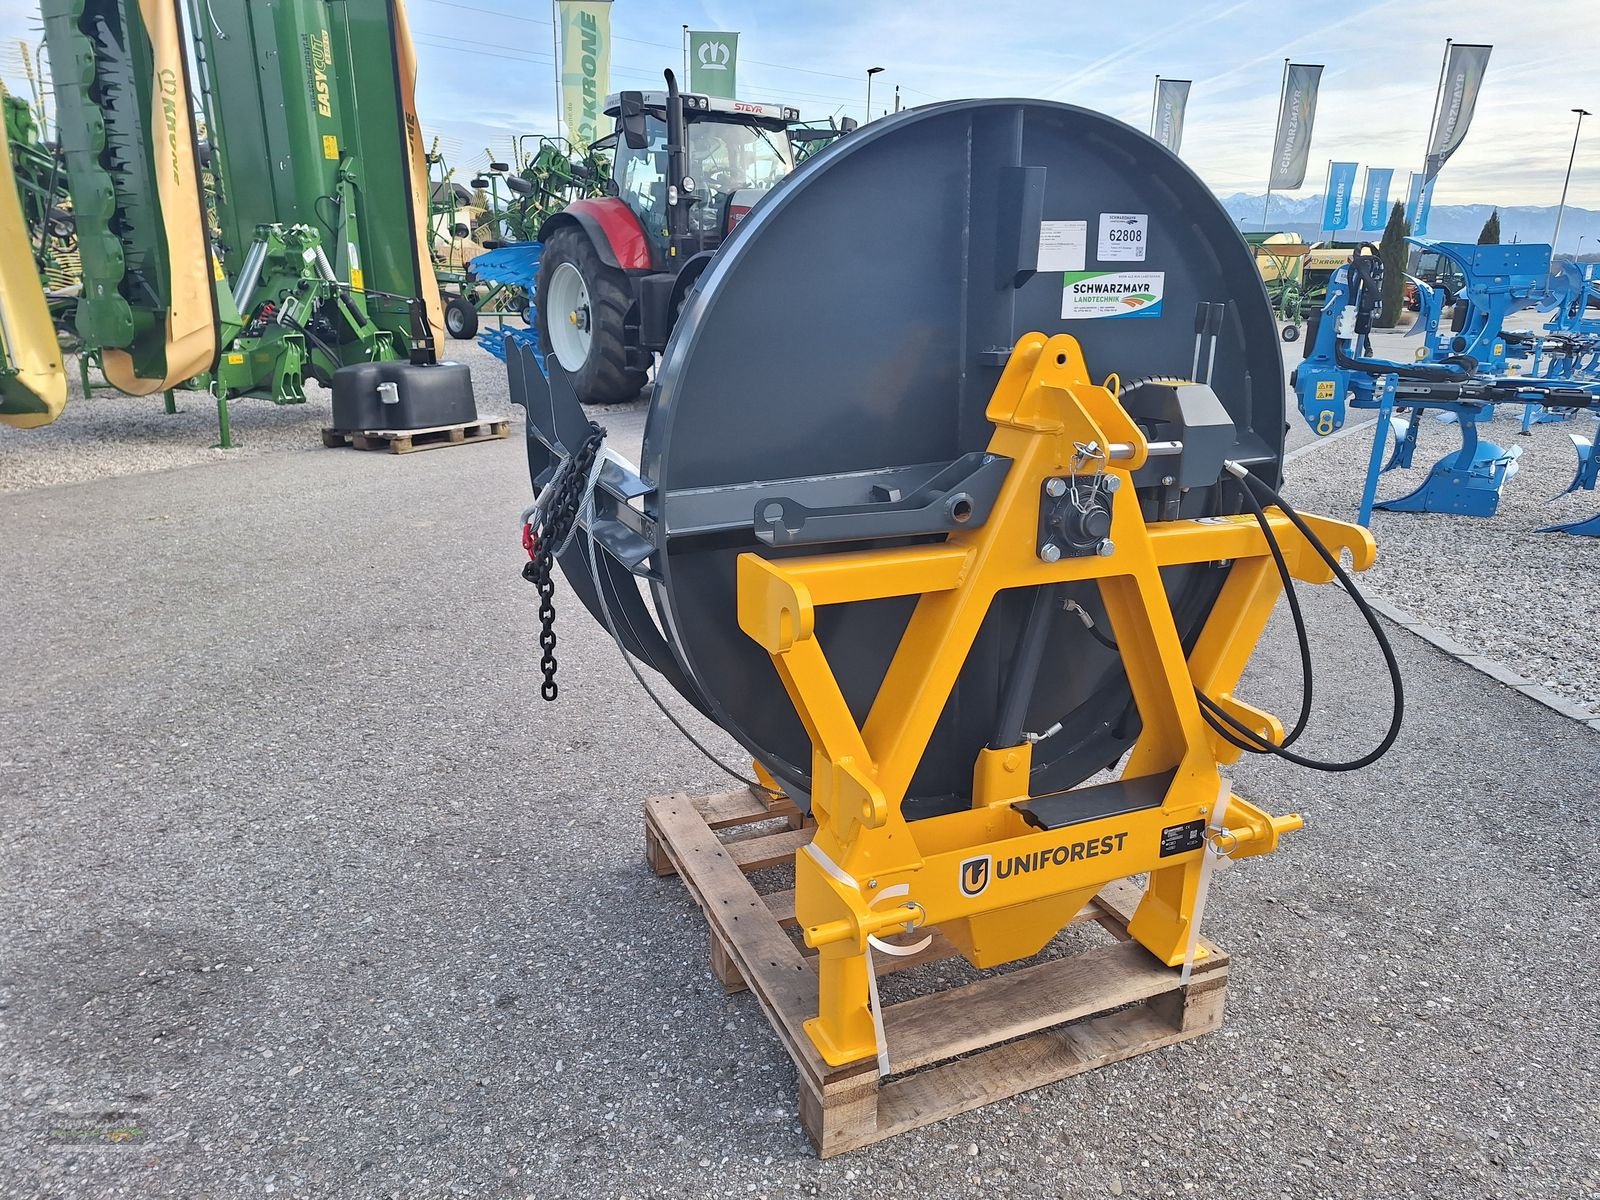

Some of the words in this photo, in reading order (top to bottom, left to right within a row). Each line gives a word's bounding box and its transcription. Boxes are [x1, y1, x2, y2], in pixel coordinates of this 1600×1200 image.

[310, 33, 332, 118] EASYCUT
[580, 10, 597, 121] KRONE
[734, 103, 763, 114] STEYR
[1160, 103, 1173, 147] RZMAYR
[1437, 74, 1466, 168] SCHWARZMAYR
[1279, 89, 1302, 175] SCHWARZMAYR
[1334, 183, 1345, 217] LEMKEN
[1371, 187, 1381, 219] LEMKEN
[1109, 229, 1142, 242] 62808
[1073, 283, 1150, 294] SCHWARZMAYR
[1073, 295, 1120, 303] LANDTECHNIK
[996, 832, 1128, 880] UNIFOREST
